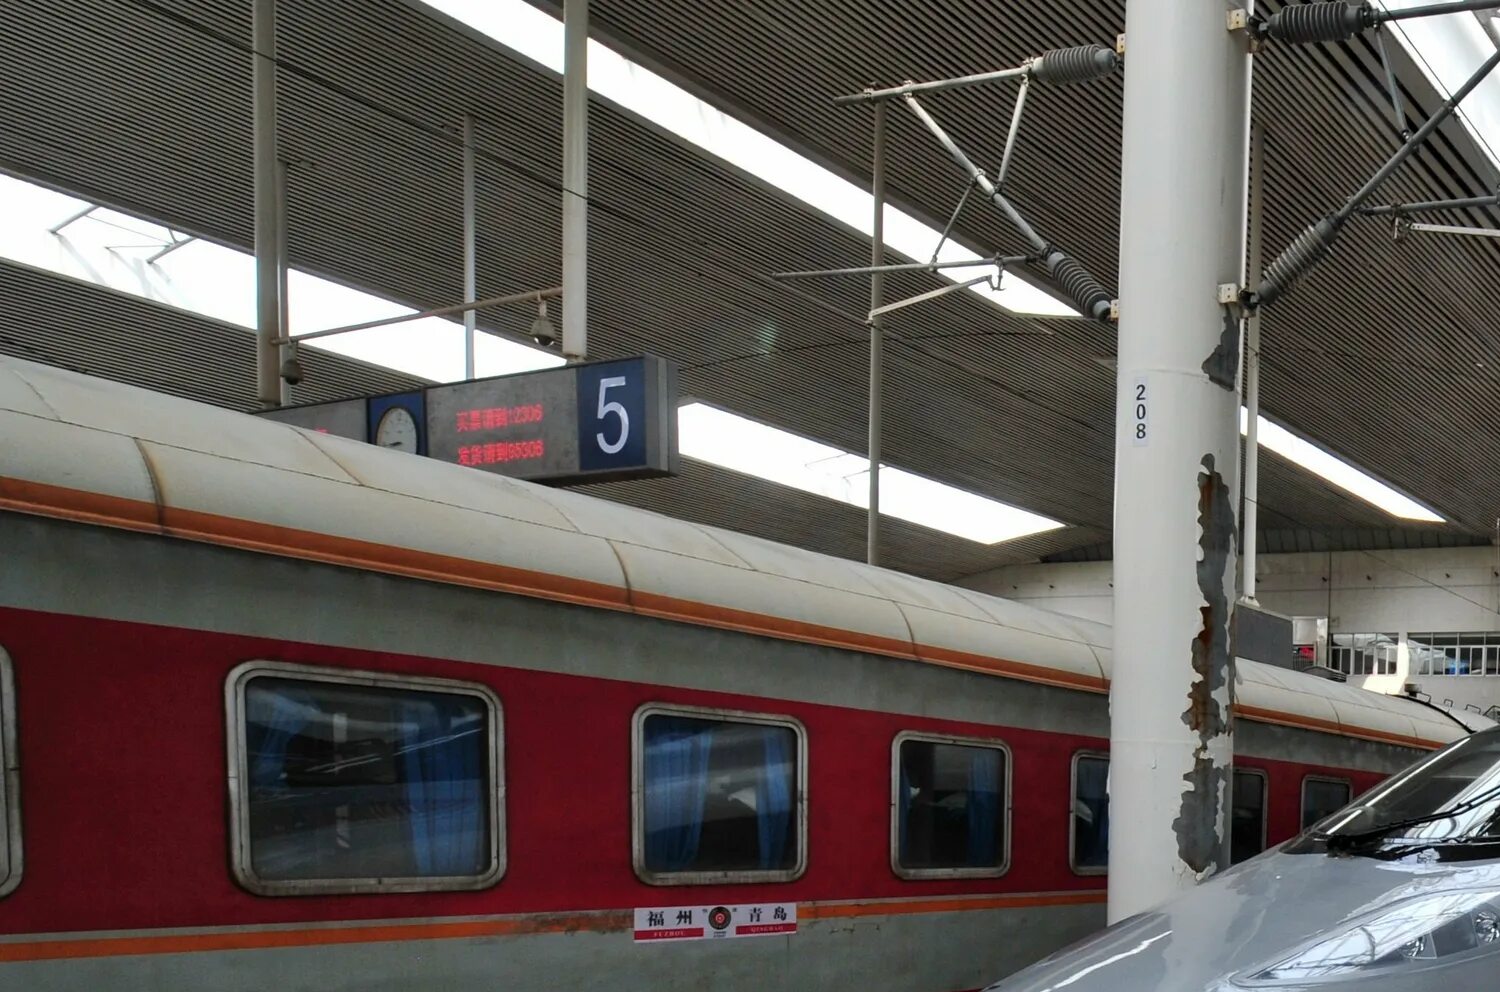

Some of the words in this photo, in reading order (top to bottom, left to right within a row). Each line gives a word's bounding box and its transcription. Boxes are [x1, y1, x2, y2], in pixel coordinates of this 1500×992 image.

[596, 375, 630, 456] 5
[1135, 384, 1147, 439] 208
[647, 910, 692, 927] 福州
[749, 906, 788, 922] 青岛
